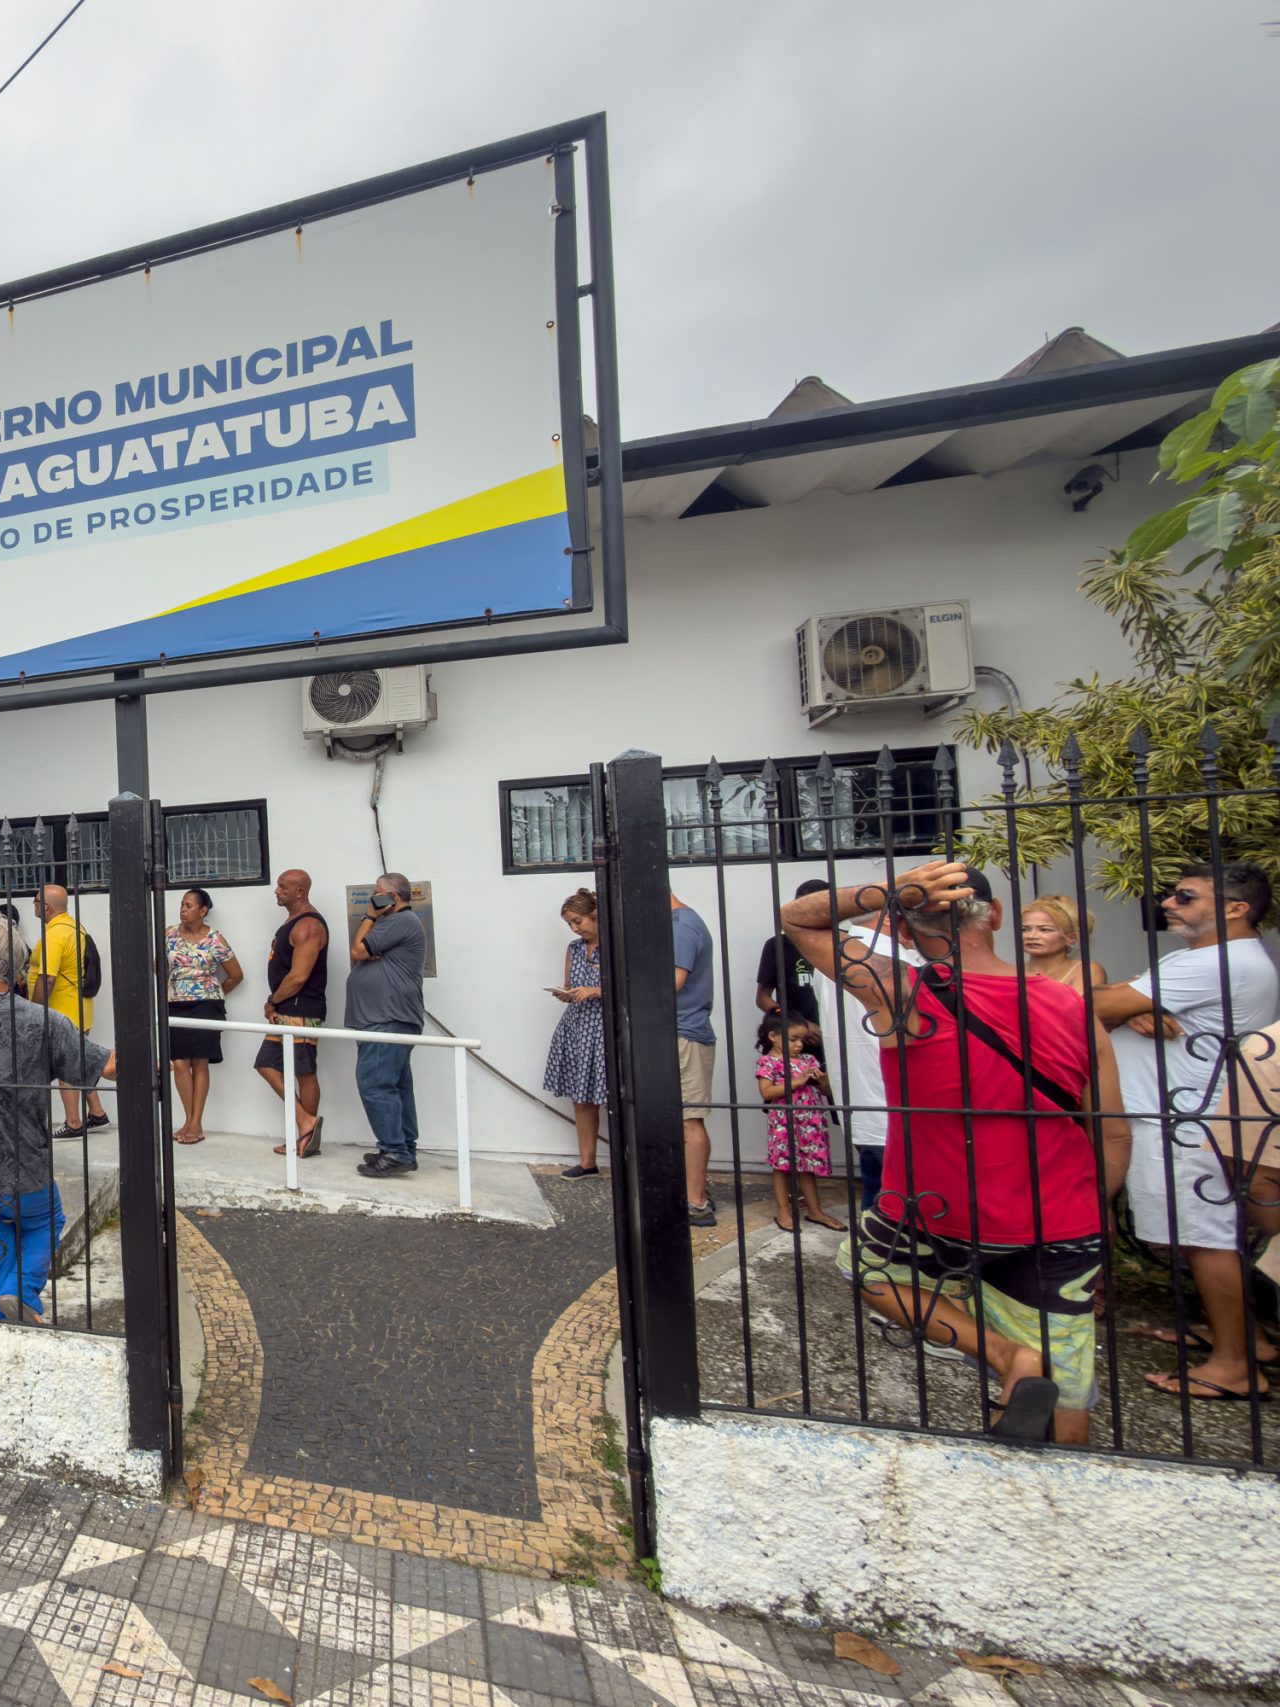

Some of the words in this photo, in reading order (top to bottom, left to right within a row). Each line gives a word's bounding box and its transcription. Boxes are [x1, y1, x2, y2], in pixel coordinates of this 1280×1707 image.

[115, 319, 413, 416] MUNICIPAL
[33, 517, 73, 544] DE
[87, 461, 373, 534] PROSPERIDADE
[929, 612, 963, 624] ELGIN
